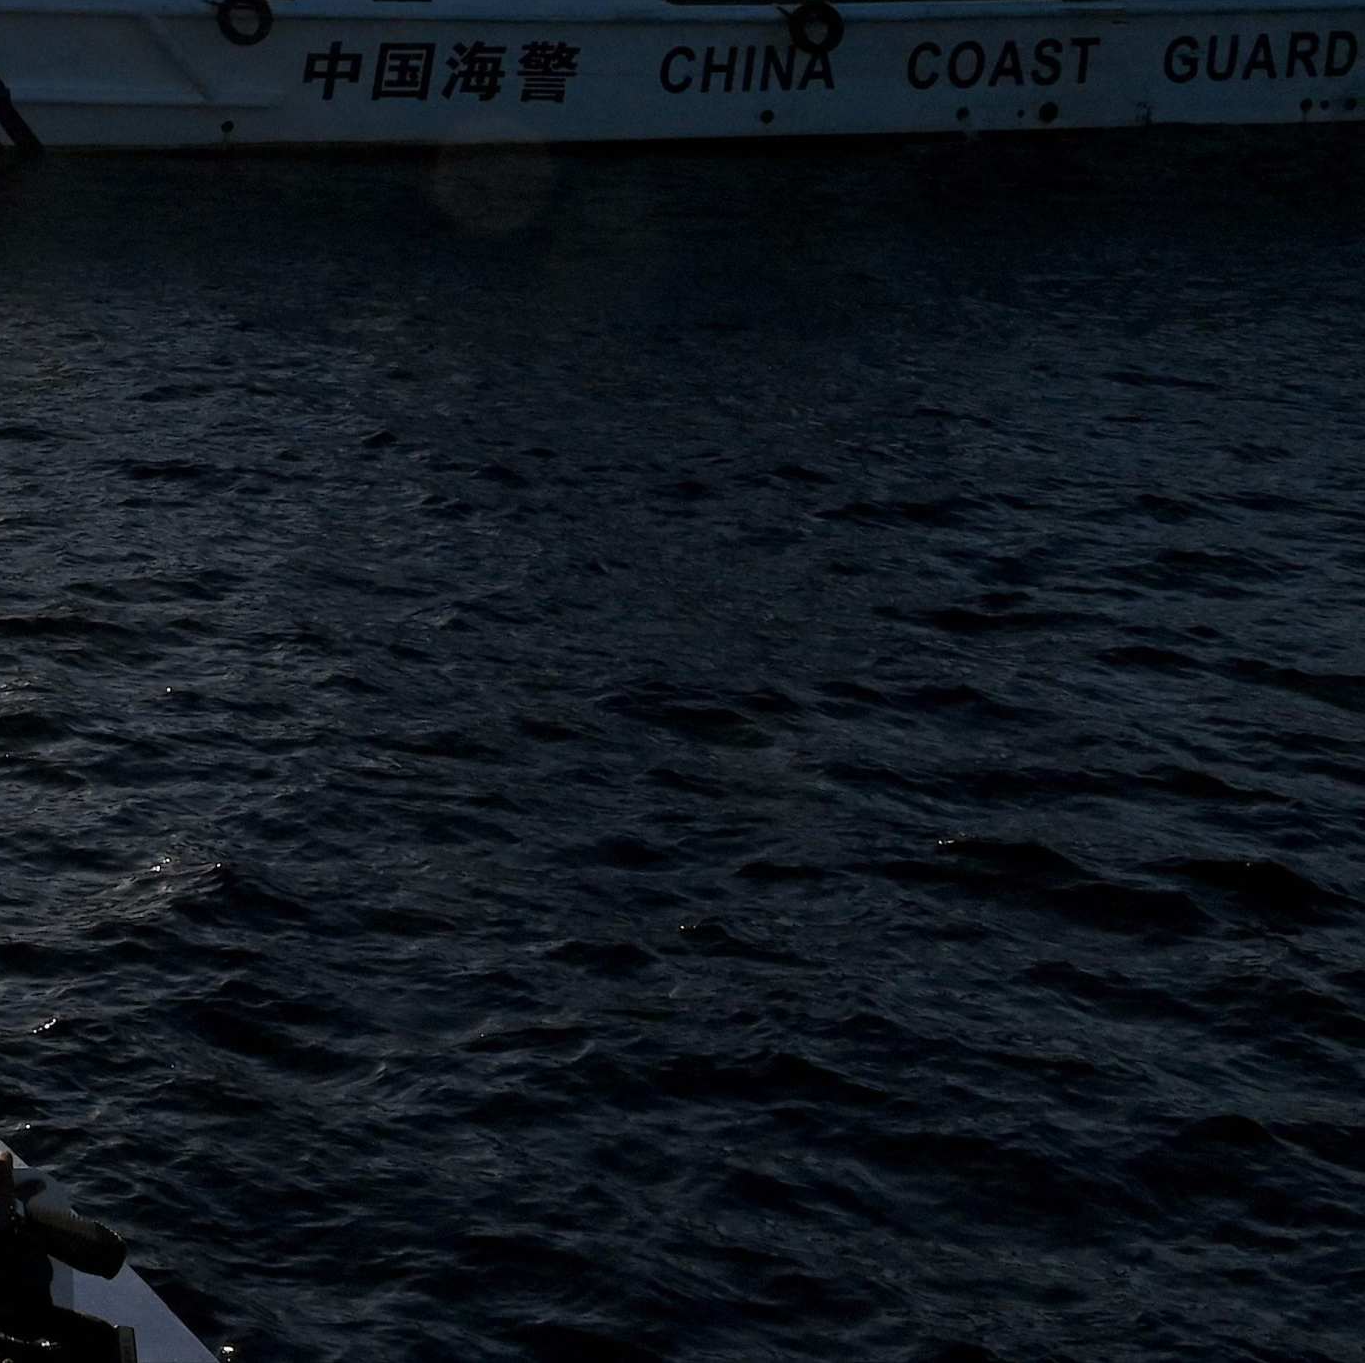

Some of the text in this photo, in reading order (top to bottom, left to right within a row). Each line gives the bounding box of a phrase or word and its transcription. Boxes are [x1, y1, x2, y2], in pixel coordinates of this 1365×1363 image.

[303, 40, 582, 103] 中国海警
[659, 30, 1358, 94] CHINA COAST GUARD
